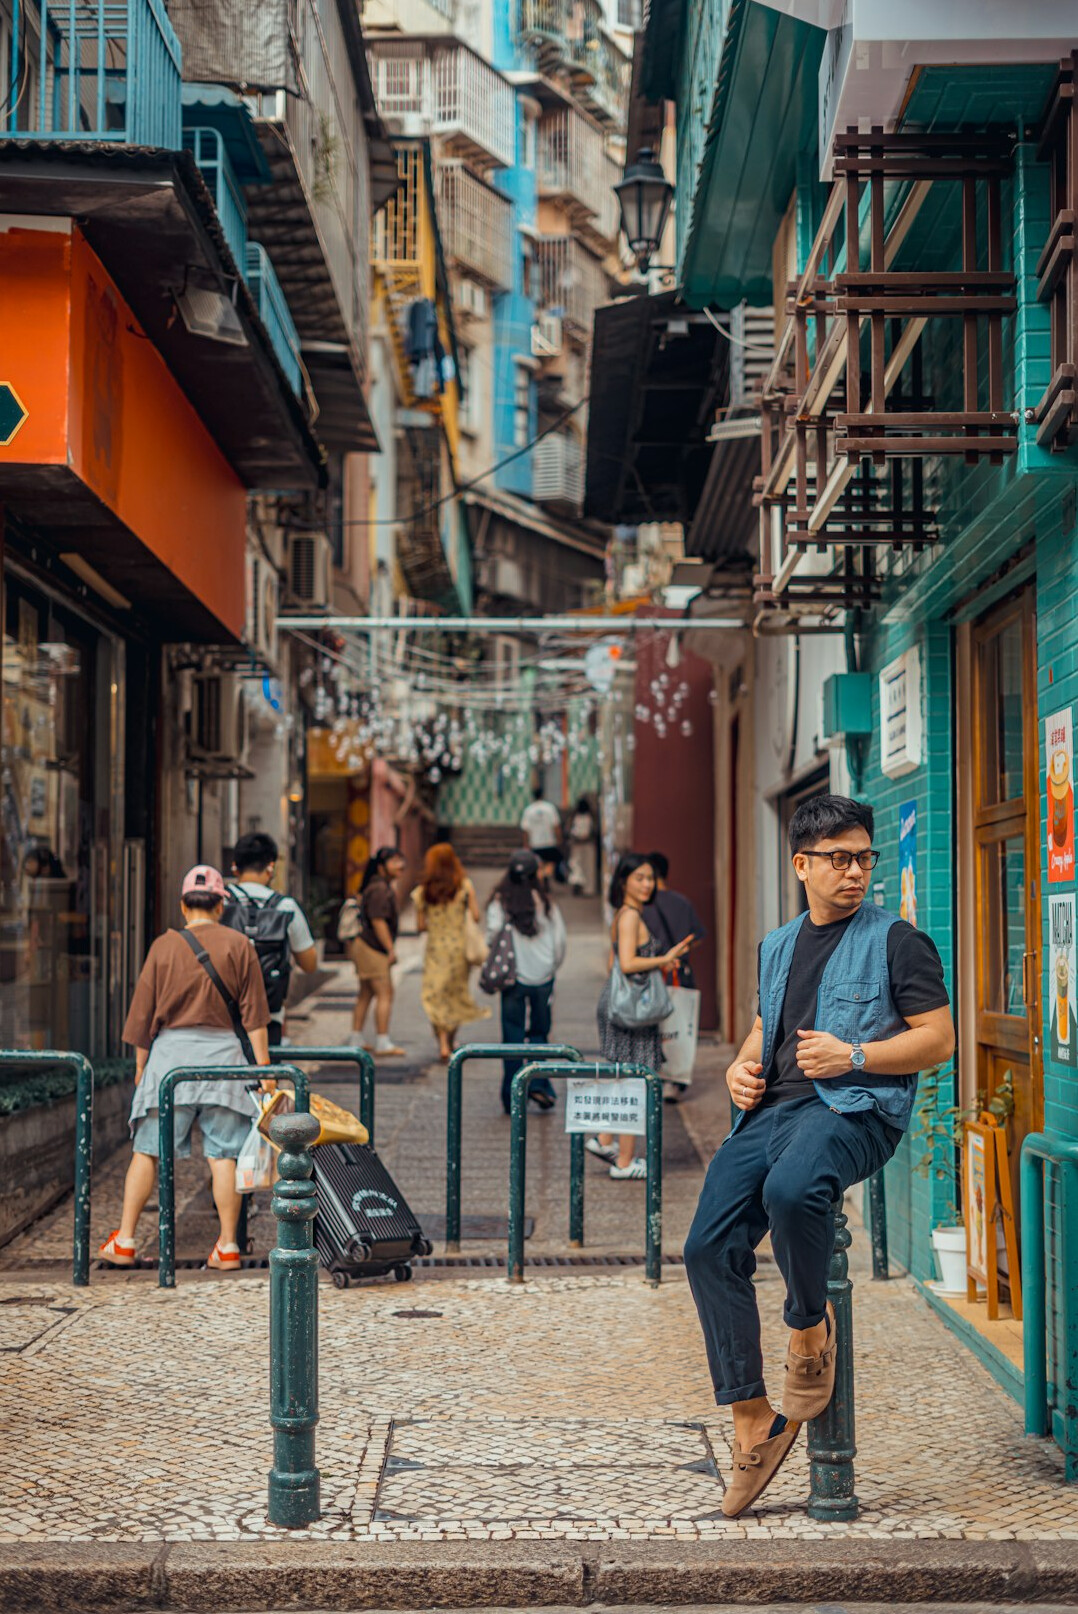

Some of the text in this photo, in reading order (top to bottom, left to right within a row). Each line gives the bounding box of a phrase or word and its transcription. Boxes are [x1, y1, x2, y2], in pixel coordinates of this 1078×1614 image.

[1052, 901, 1072, 944] MATCHA
[574, 1095, 639, 1106] 如發現非法移動
